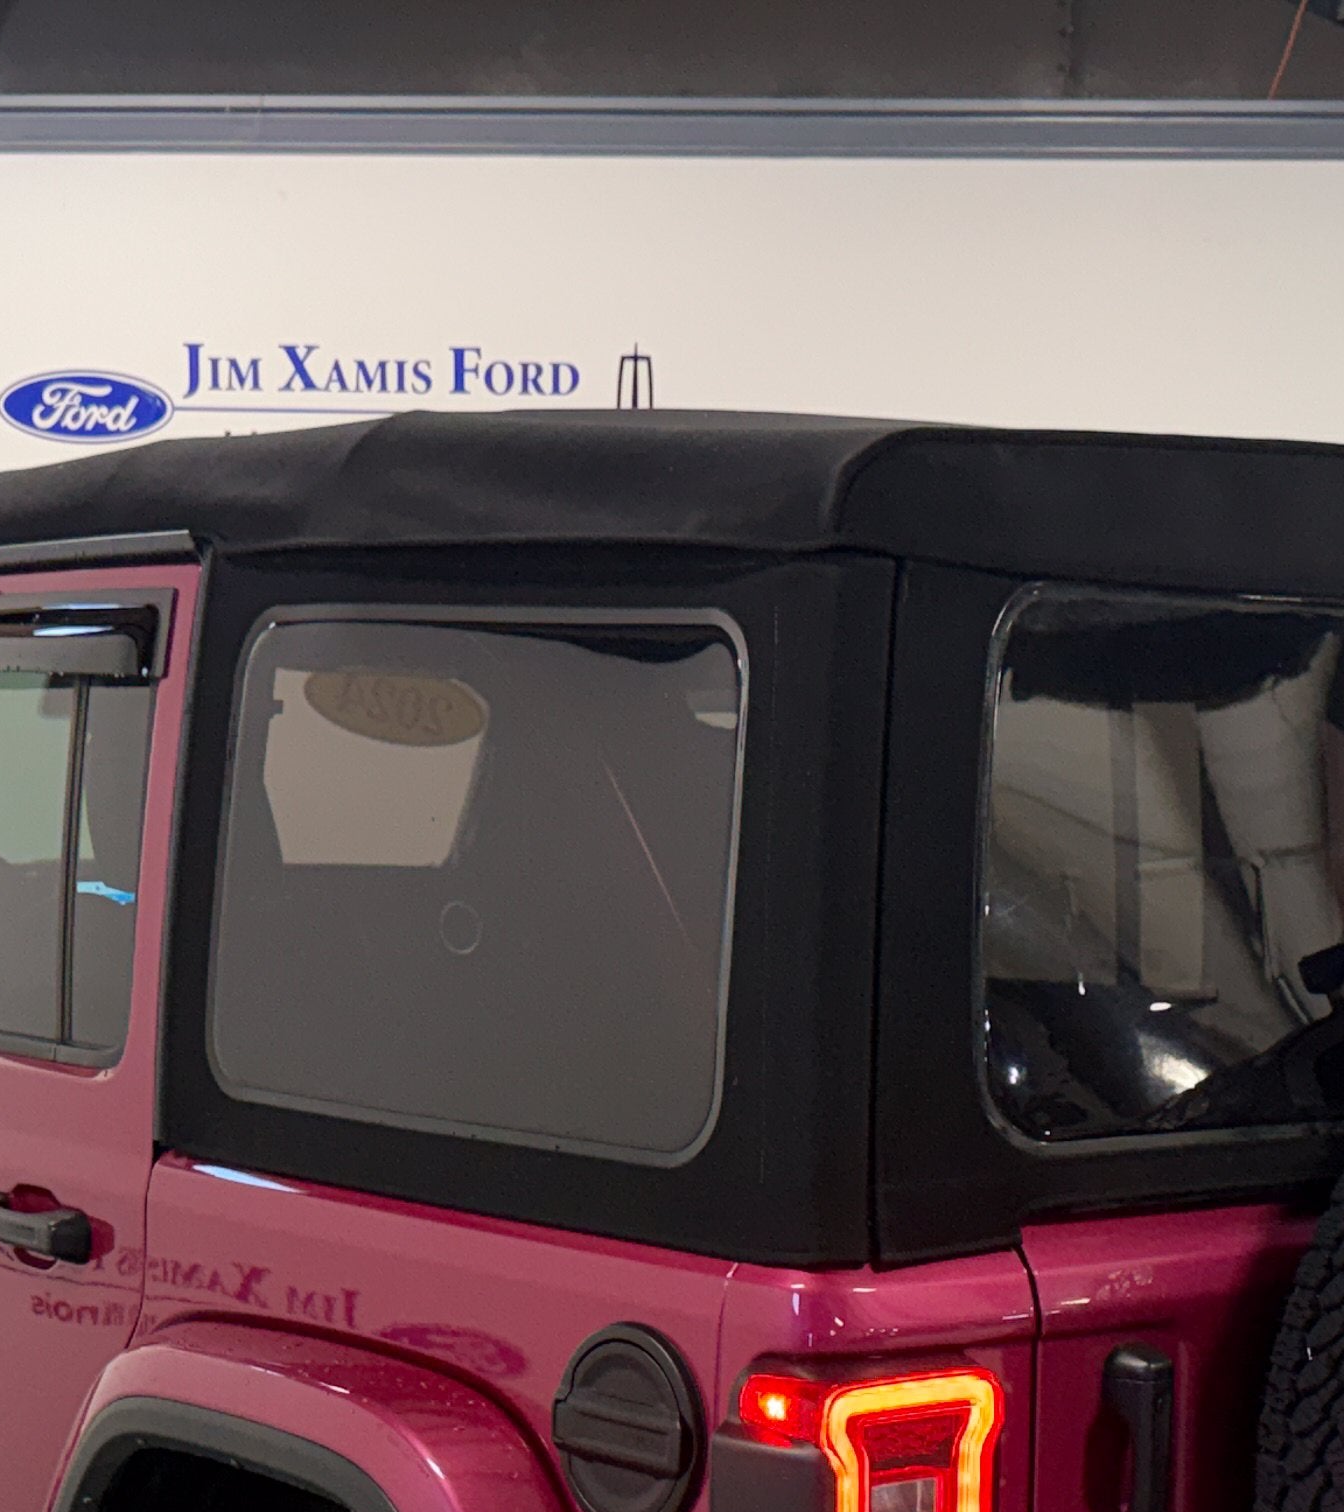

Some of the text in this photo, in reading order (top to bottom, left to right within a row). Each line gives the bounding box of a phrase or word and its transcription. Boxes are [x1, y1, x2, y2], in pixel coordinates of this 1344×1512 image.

[182, 342, 580, 399] JIM XAMIS FORD
[32, 382, 137, 434] Ford
